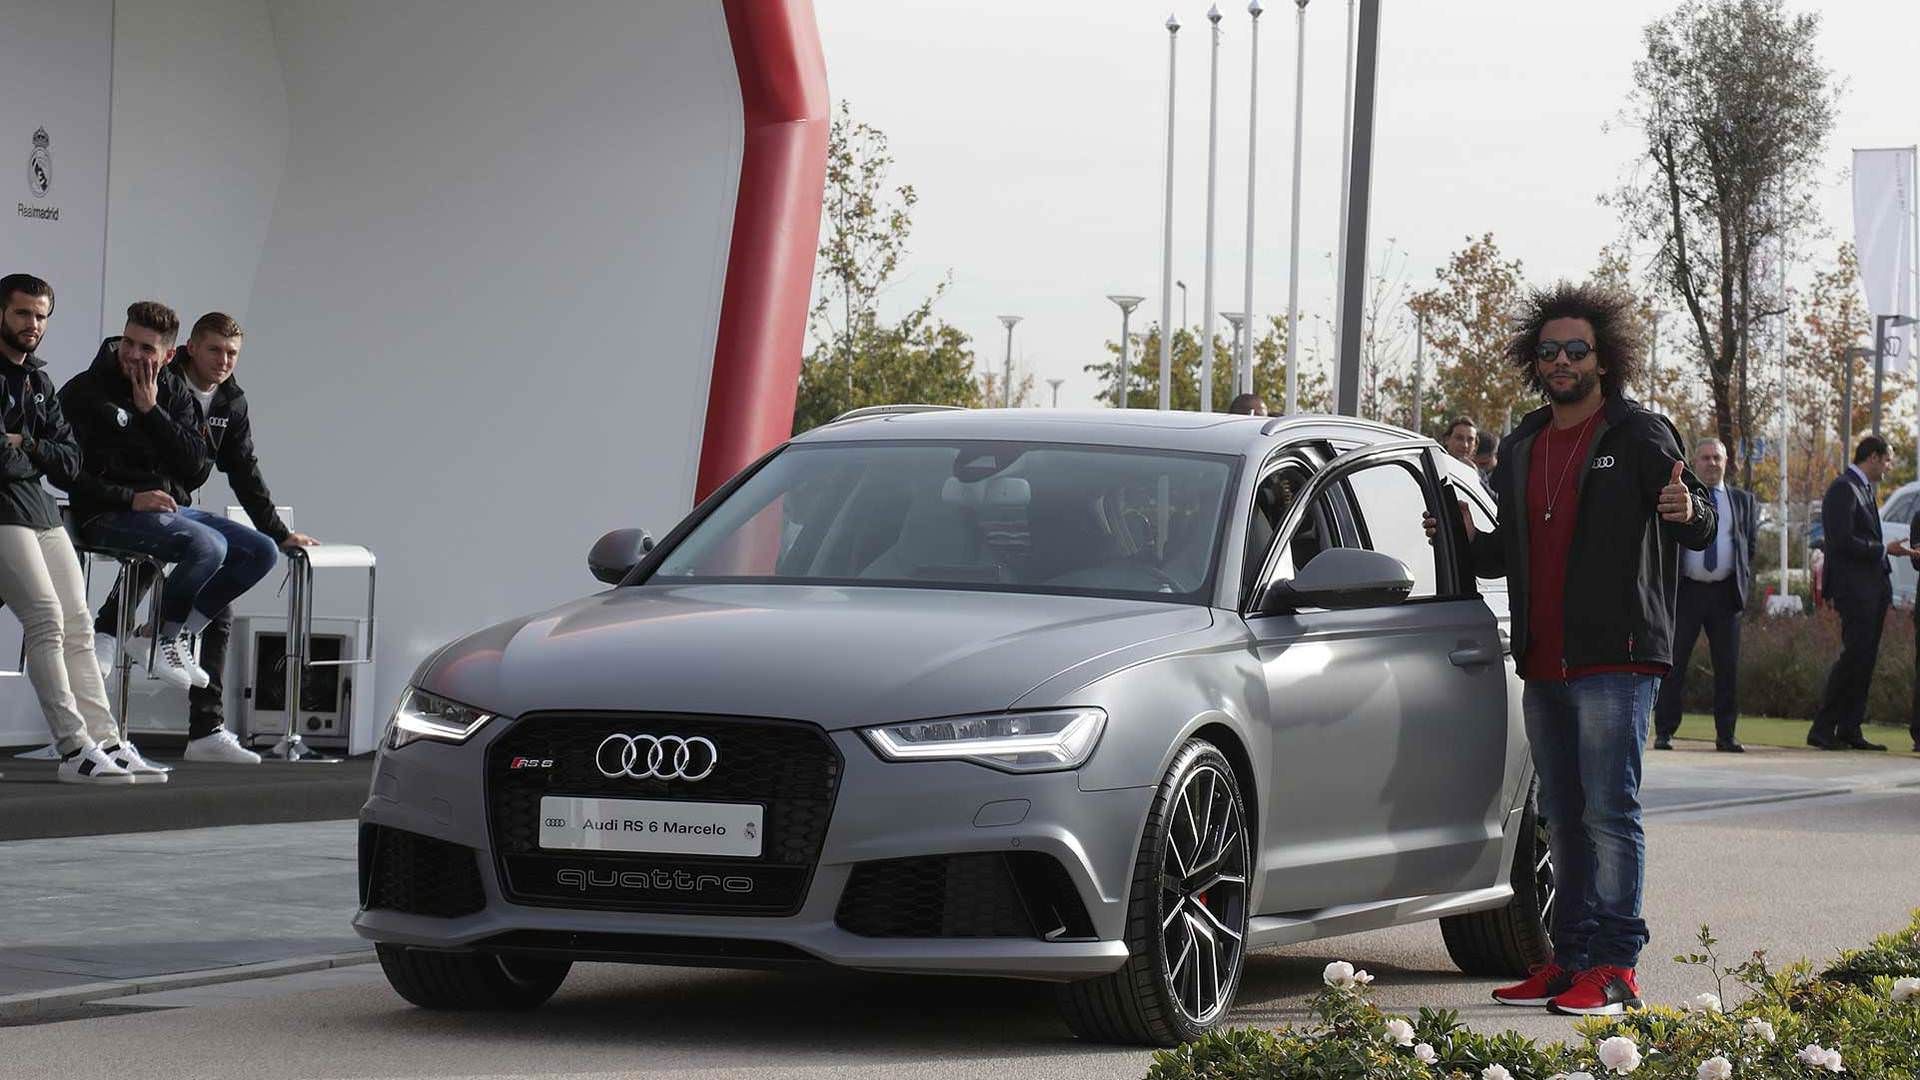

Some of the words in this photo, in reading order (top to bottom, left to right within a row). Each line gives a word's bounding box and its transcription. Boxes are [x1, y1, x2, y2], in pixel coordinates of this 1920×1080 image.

[582, 819, 618, 832] Audi
[623, 820, 644, 832] RS
[648, 821, 658, 833] 6
[663, 821, 727, 836] Marcelo
[557, 868, 753, 893] quattro
